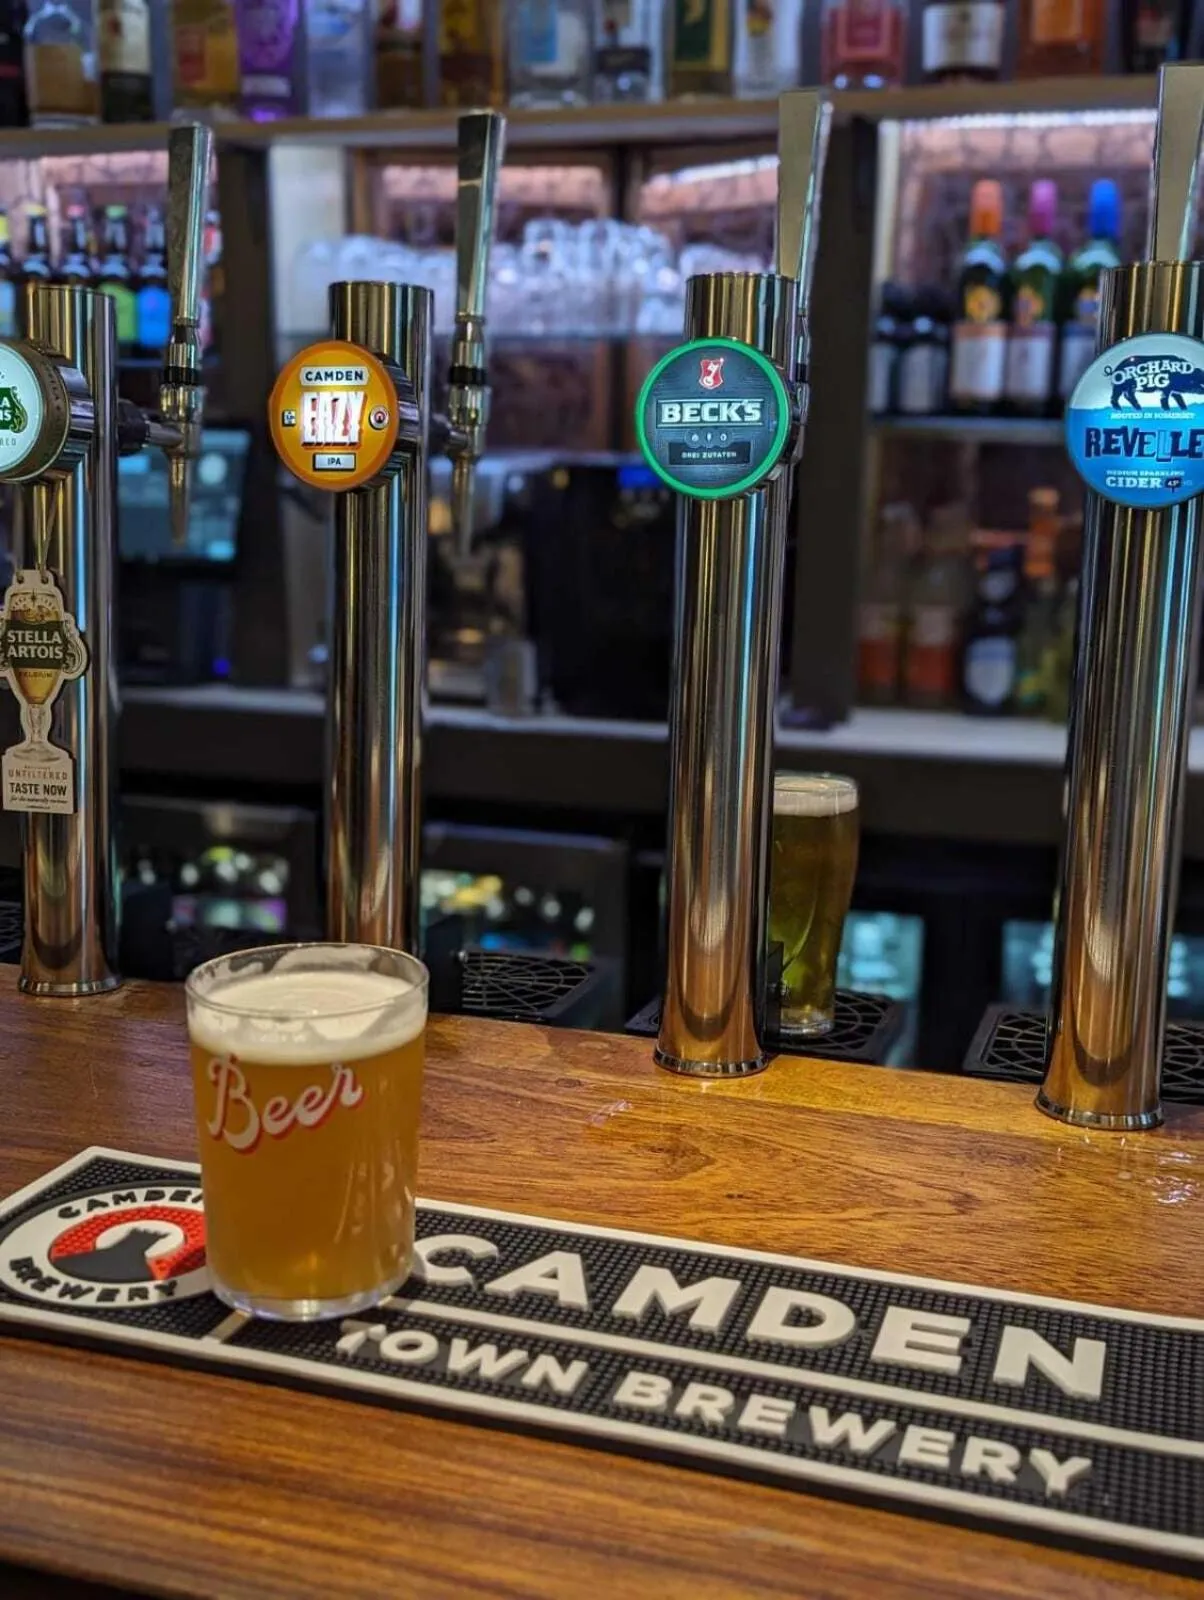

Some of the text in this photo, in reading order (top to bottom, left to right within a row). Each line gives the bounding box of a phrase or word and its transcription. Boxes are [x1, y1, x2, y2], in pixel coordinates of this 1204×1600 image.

[305, 370, 364, 382] CAMDEN
[1112, 359, 1195, 385] ORCHARD
[1135, 373, 1171, 391] PIG
[661, 400, 760, 422] BECK'S
[327, 457, 342, 466] IPA
[1105, 476, 1162, 488] CIDER
[7, 629, 62, 644] STELLA
[7, 645, 64, 660] ARTOIS
[9, 782, 67, 796] TASTE NOW
[206, 1053, 365, 1155] Beer
[9, 1256, 178, 1304] BREWERY
[414, 1232, 1107, 1401] CAMDEN
[336, 1319, 1092, 1498] TOWN BREWERY
